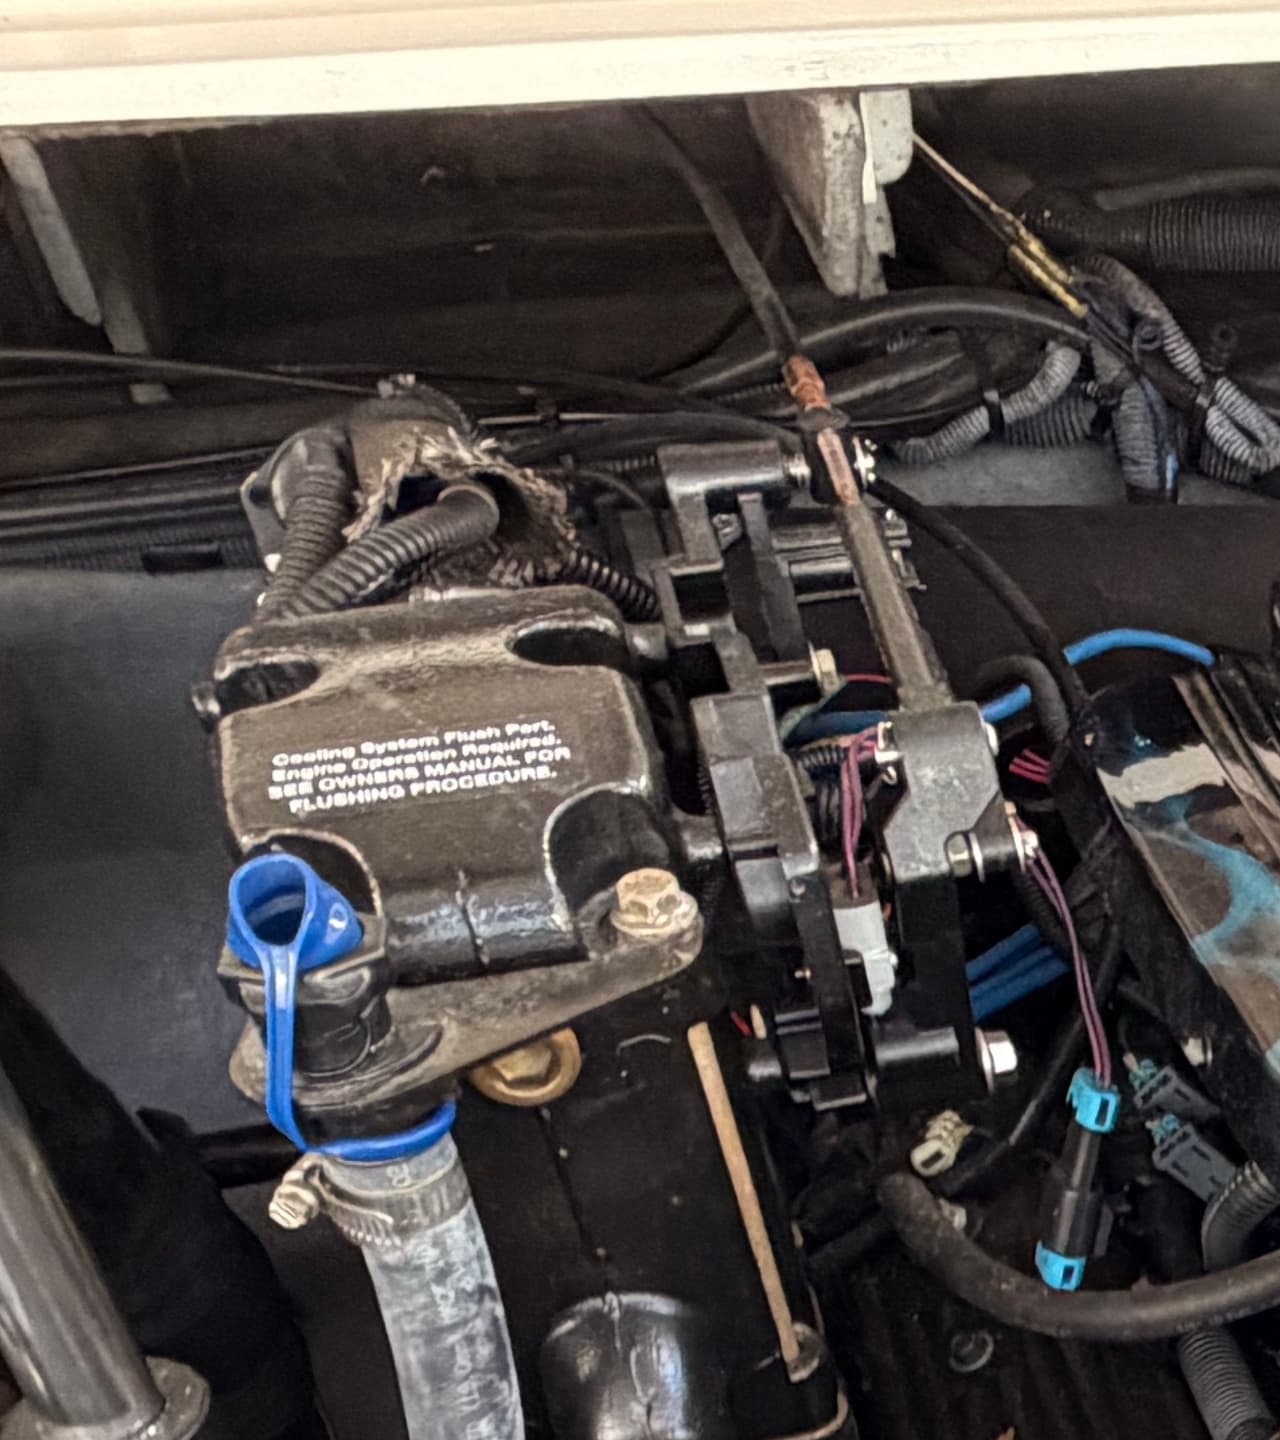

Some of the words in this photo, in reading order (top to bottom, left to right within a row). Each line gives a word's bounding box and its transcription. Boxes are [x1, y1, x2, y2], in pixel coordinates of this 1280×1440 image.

[271, 746, 356, 768] Cooling
[360, 735, 440, 755] System
[443, 726, 502, 745] Flush
[504, 719, 556, 737] Port.
[271, 761, 347, 783] Engine
[351, 748, 457, 772] Operation
[268, 783, 314, 801] SEE
[318, 766, 420, 793] OWNERS
[424, 754, 521, 778] MANUAL
[524, 746, 572, 764] FOR
[288, 783, 406, 814] FLUSHING
[409, 764, 558, 797] PROCEDURE.
